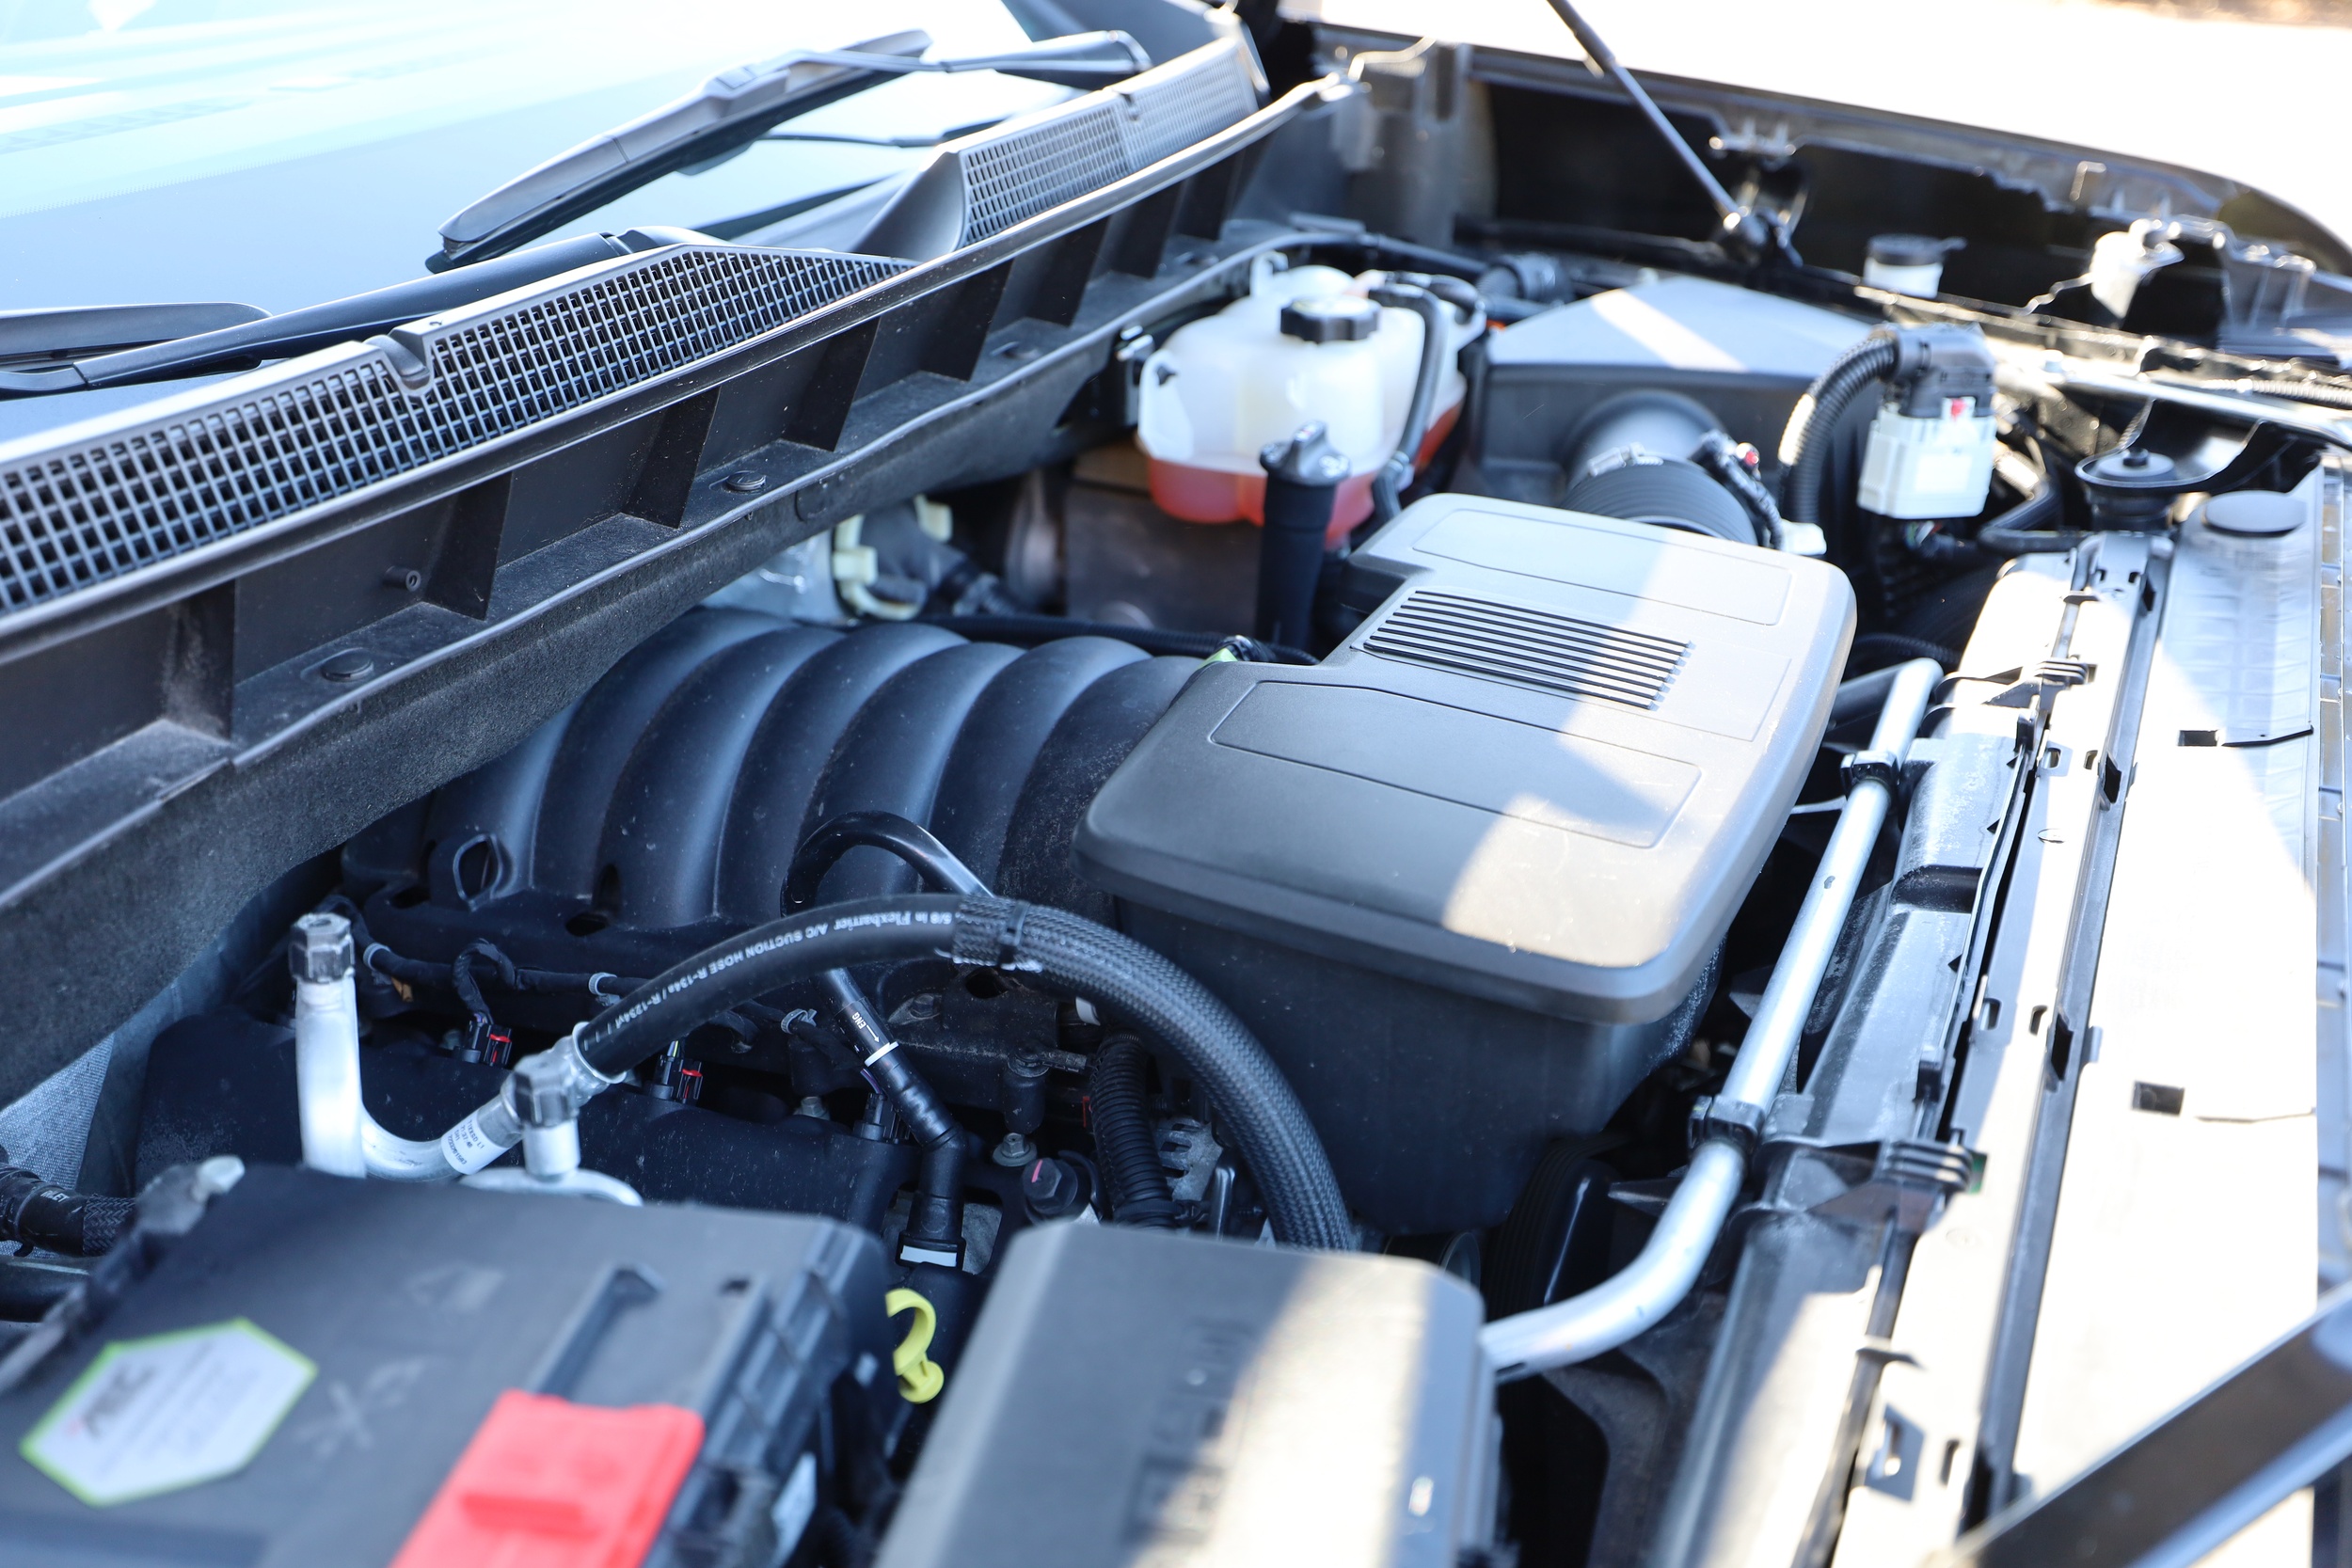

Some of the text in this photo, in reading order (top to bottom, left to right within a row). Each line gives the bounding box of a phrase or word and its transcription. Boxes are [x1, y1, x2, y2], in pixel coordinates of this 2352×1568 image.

[834, 911, 912, 931] Flexbarrier
[914, 911, 929, 924] in
[804, 923, 829, 939] A/C
[745, 929, 803, 958] SUCTION
[708, 950, 744, 974] HOSE
[667, 966, 708, 993] R-134a
[851, 1011, 866, 1030] ENG
